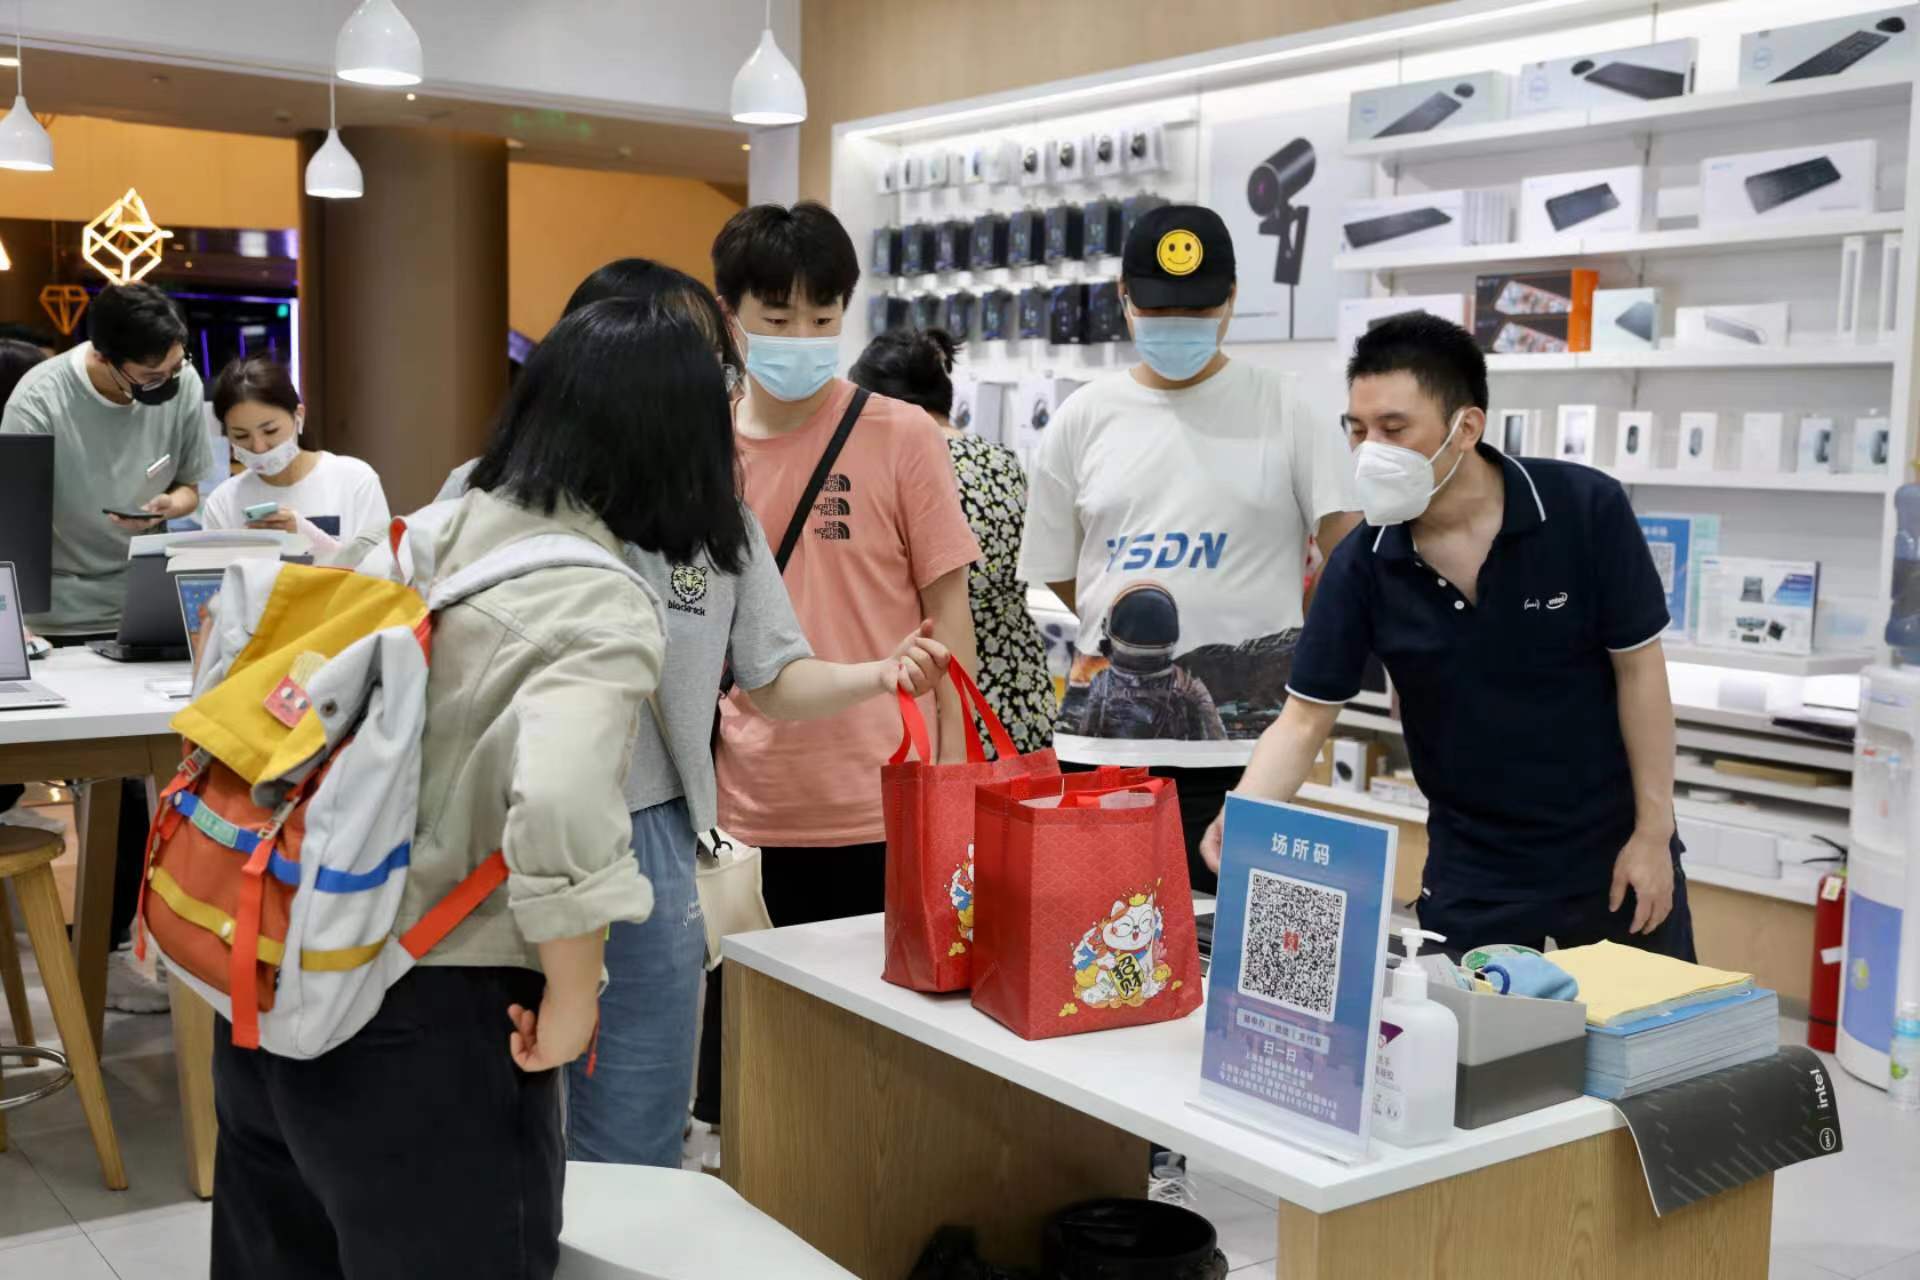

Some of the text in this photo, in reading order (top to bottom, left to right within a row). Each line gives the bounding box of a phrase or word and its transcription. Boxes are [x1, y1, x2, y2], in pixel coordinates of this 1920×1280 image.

[1271, 832, 1330, 866] 场所码
[1263, 1039, 1297, 1063] 扫一扫
[1809, 1068, 1829, 1109] intel
